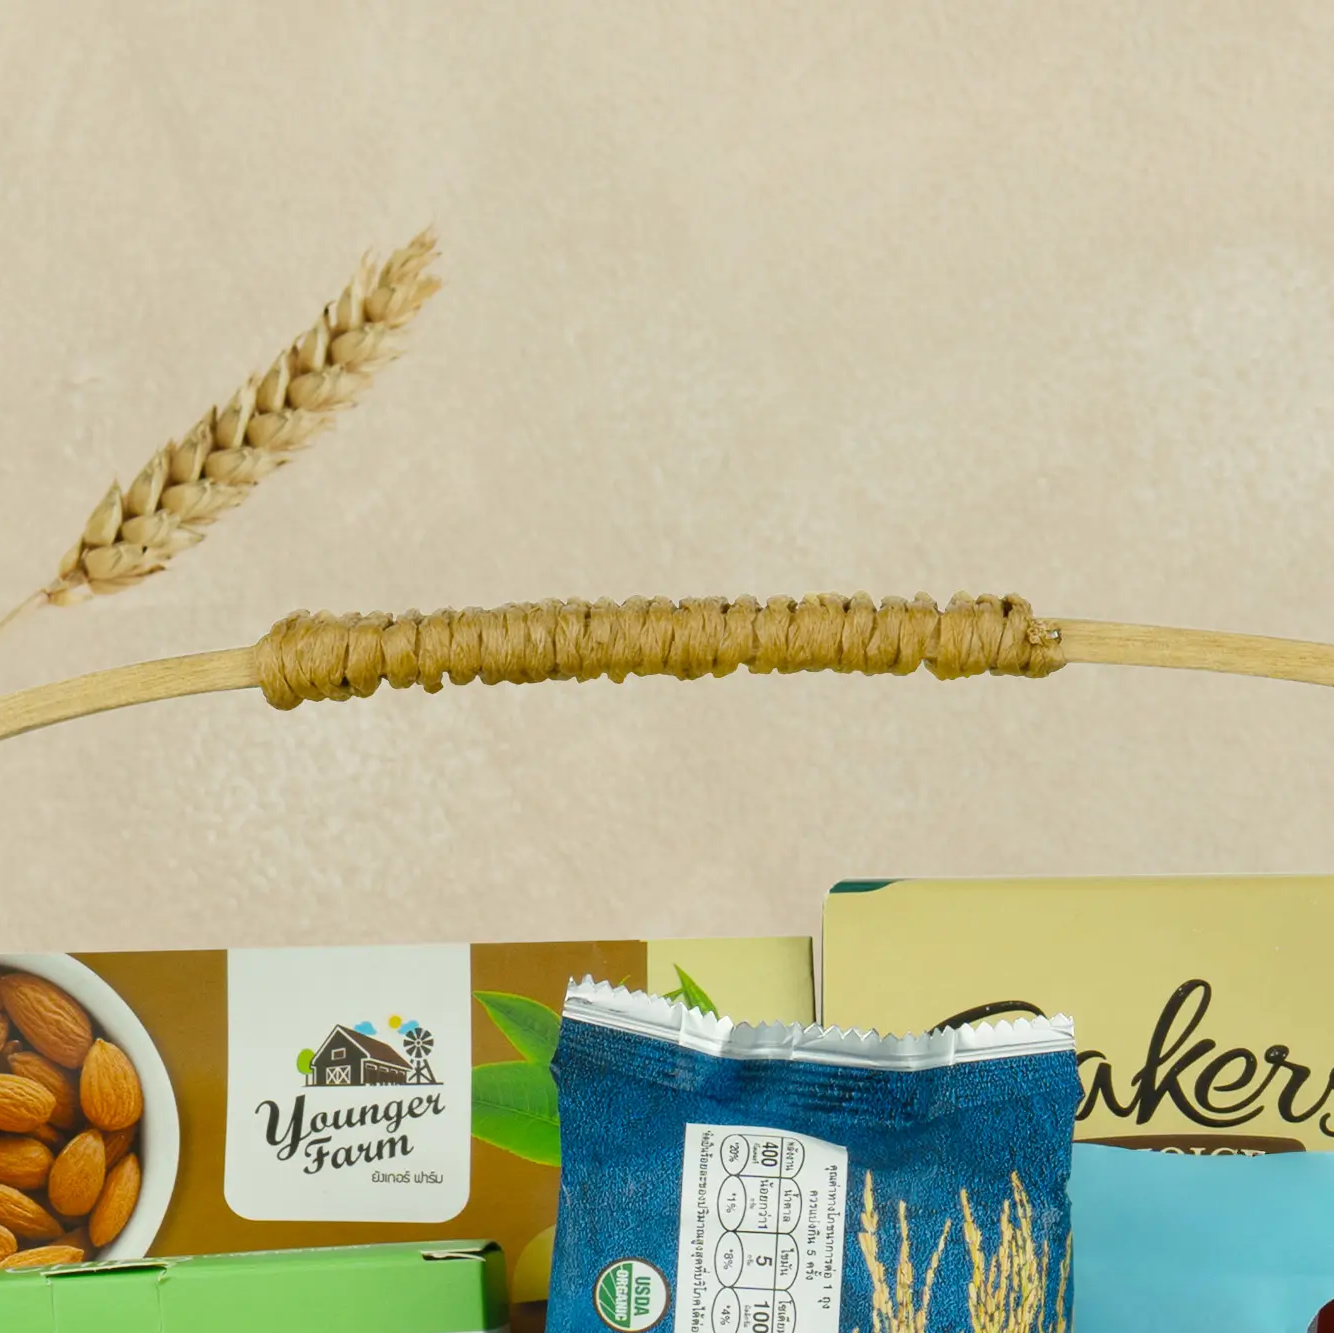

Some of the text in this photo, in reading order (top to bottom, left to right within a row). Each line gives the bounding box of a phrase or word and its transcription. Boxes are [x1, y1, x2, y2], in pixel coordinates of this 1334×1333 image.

[255, 1094, 445, 1161] Younger
[303, 1134, 414, 1175] Farm
[761, 1142, 779, 1167] 400
[756, 1255, 772, 1266] 5
[615, 1270, 629, 1321] ORGANIC
[634, 1276, 651, 1316] USDA
[752, 1301, 769, 1333] 100
